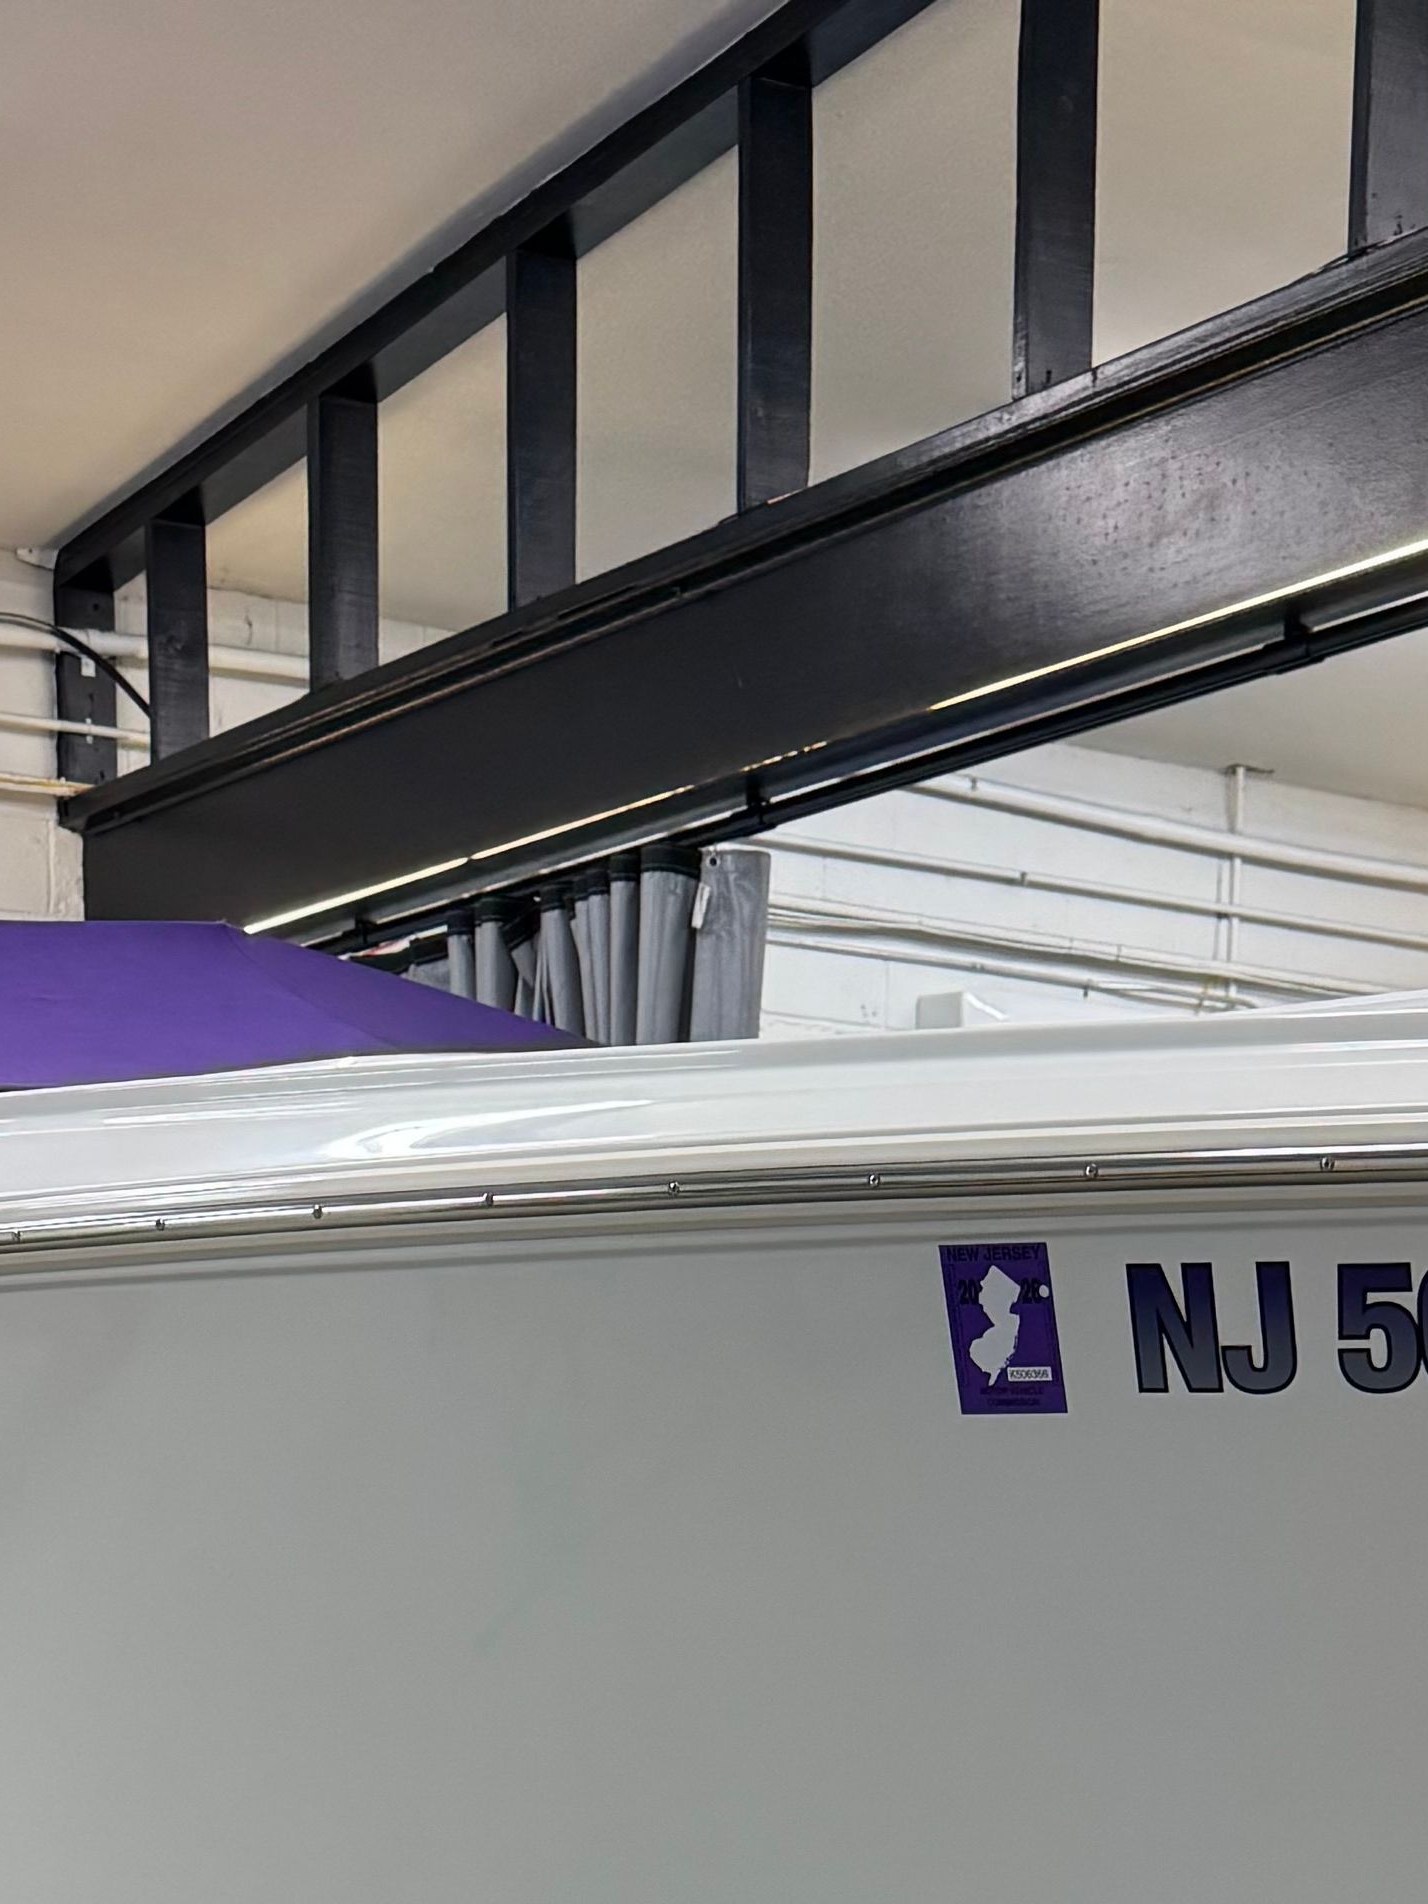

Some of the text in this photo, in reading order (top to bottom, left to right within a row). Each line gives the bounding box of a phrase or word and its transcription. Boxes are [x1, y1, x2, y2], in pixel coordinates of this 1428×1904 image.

[946, 1244, 1040, 1262] NEW JERSEY
[1125, 1261, 1298, 1393] NJ
